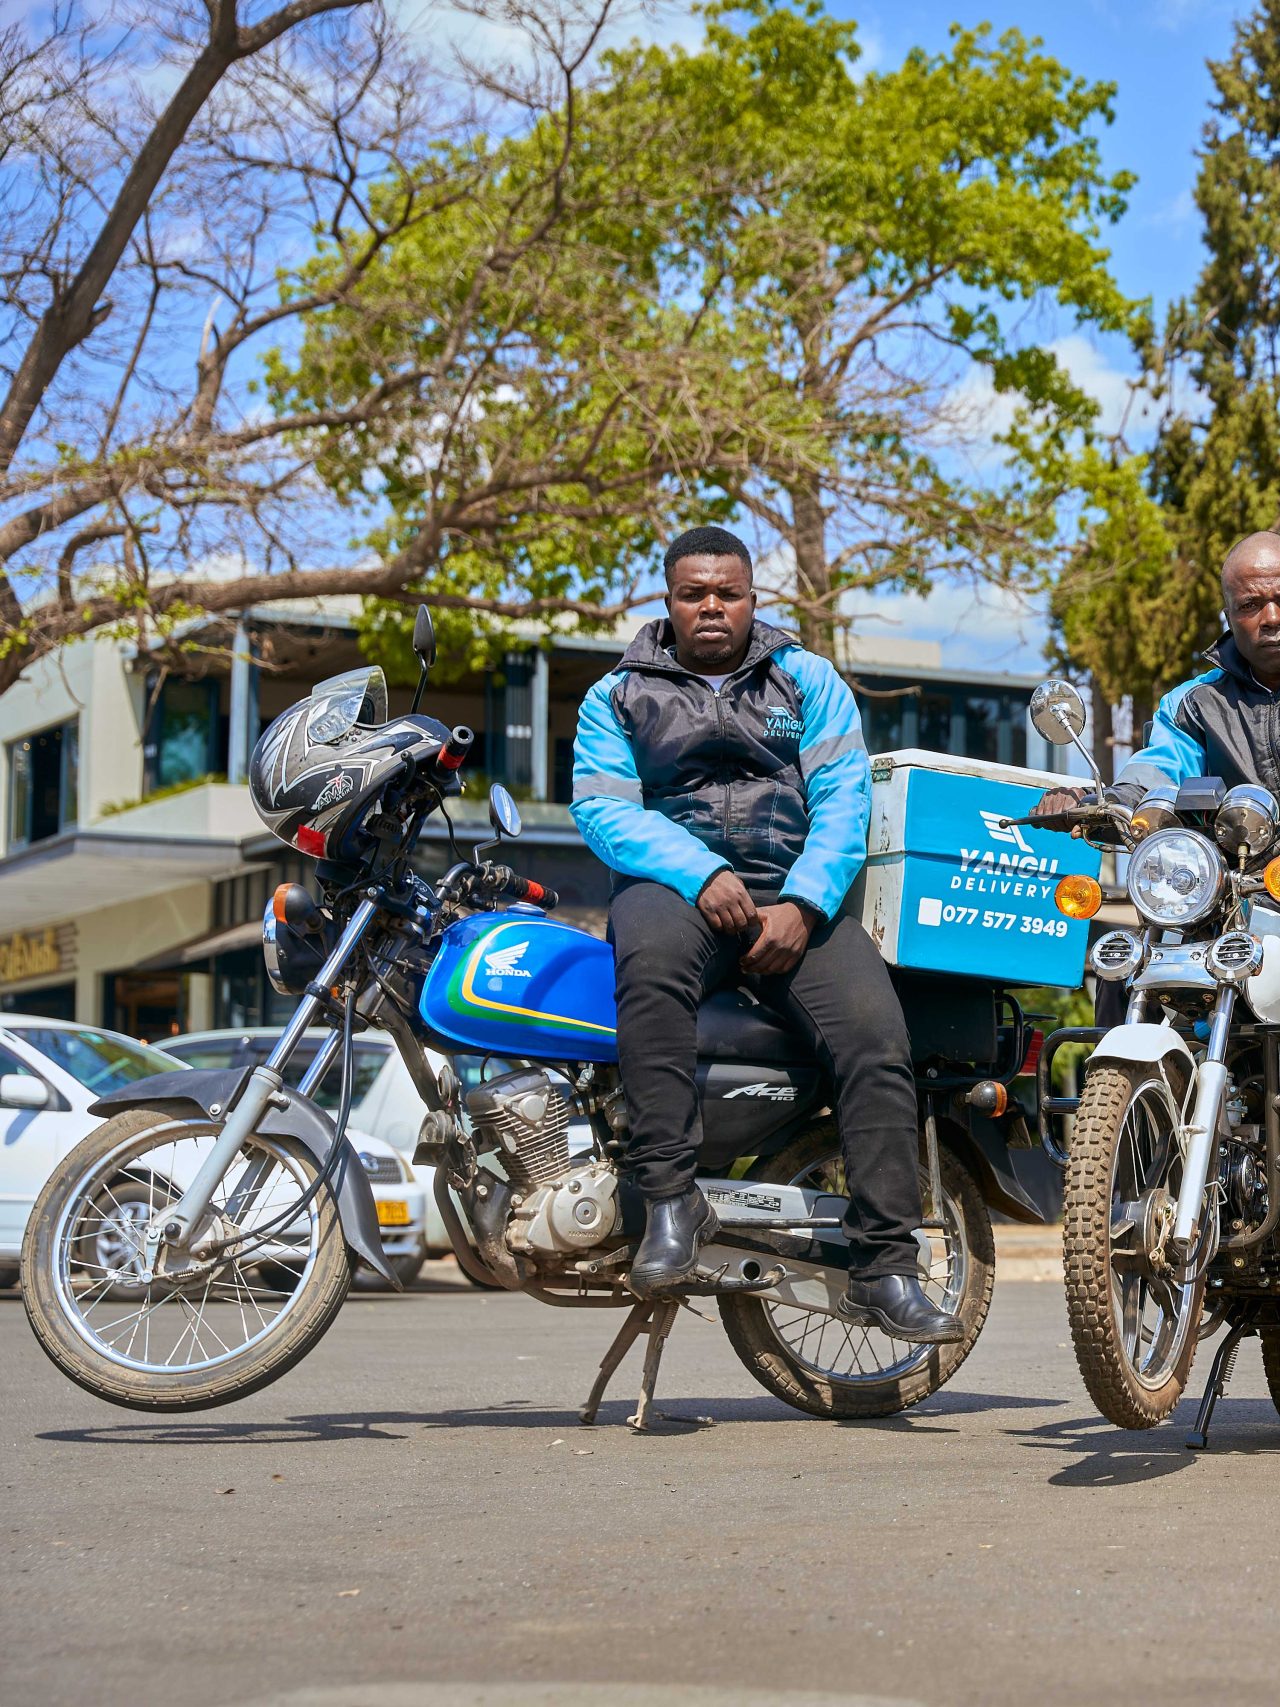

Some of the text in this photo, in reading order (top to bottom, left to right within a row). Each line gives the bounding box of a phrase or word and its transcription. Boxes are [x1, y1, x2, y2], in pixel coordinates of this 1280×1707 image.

[765, 717, 805, 731] YANGU
[960, 848, 1058, 881] YANGU
[950, 875, 1052, 899] DELIVERY
[942, 905, 1068, 938] 077 577 3949
[485, 968, 533, 978] HONDA
